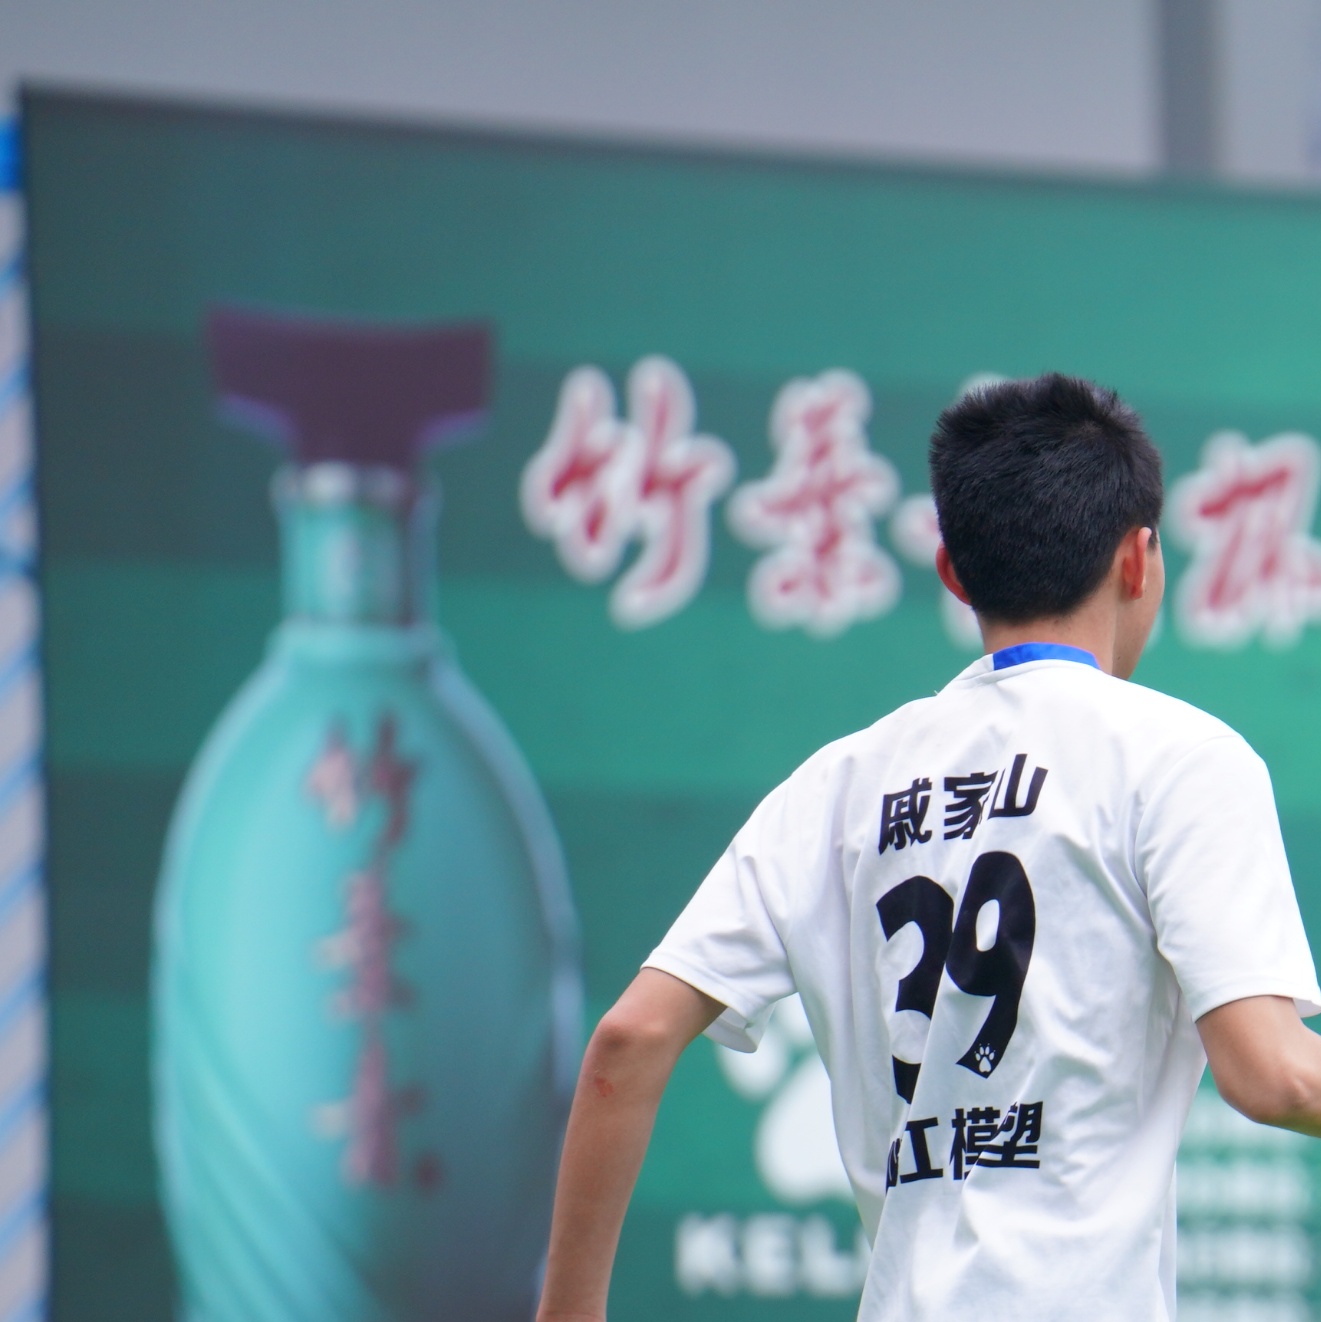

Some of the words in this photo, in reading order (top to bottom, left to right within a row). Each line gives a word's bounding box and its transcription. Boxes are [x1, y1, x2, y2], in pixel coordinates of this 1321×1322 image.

[878, 753, 1049, 856] 戚家山
[876, 851, 1036, 1105] 39
[677, 1213, 872, 1298] KEL
